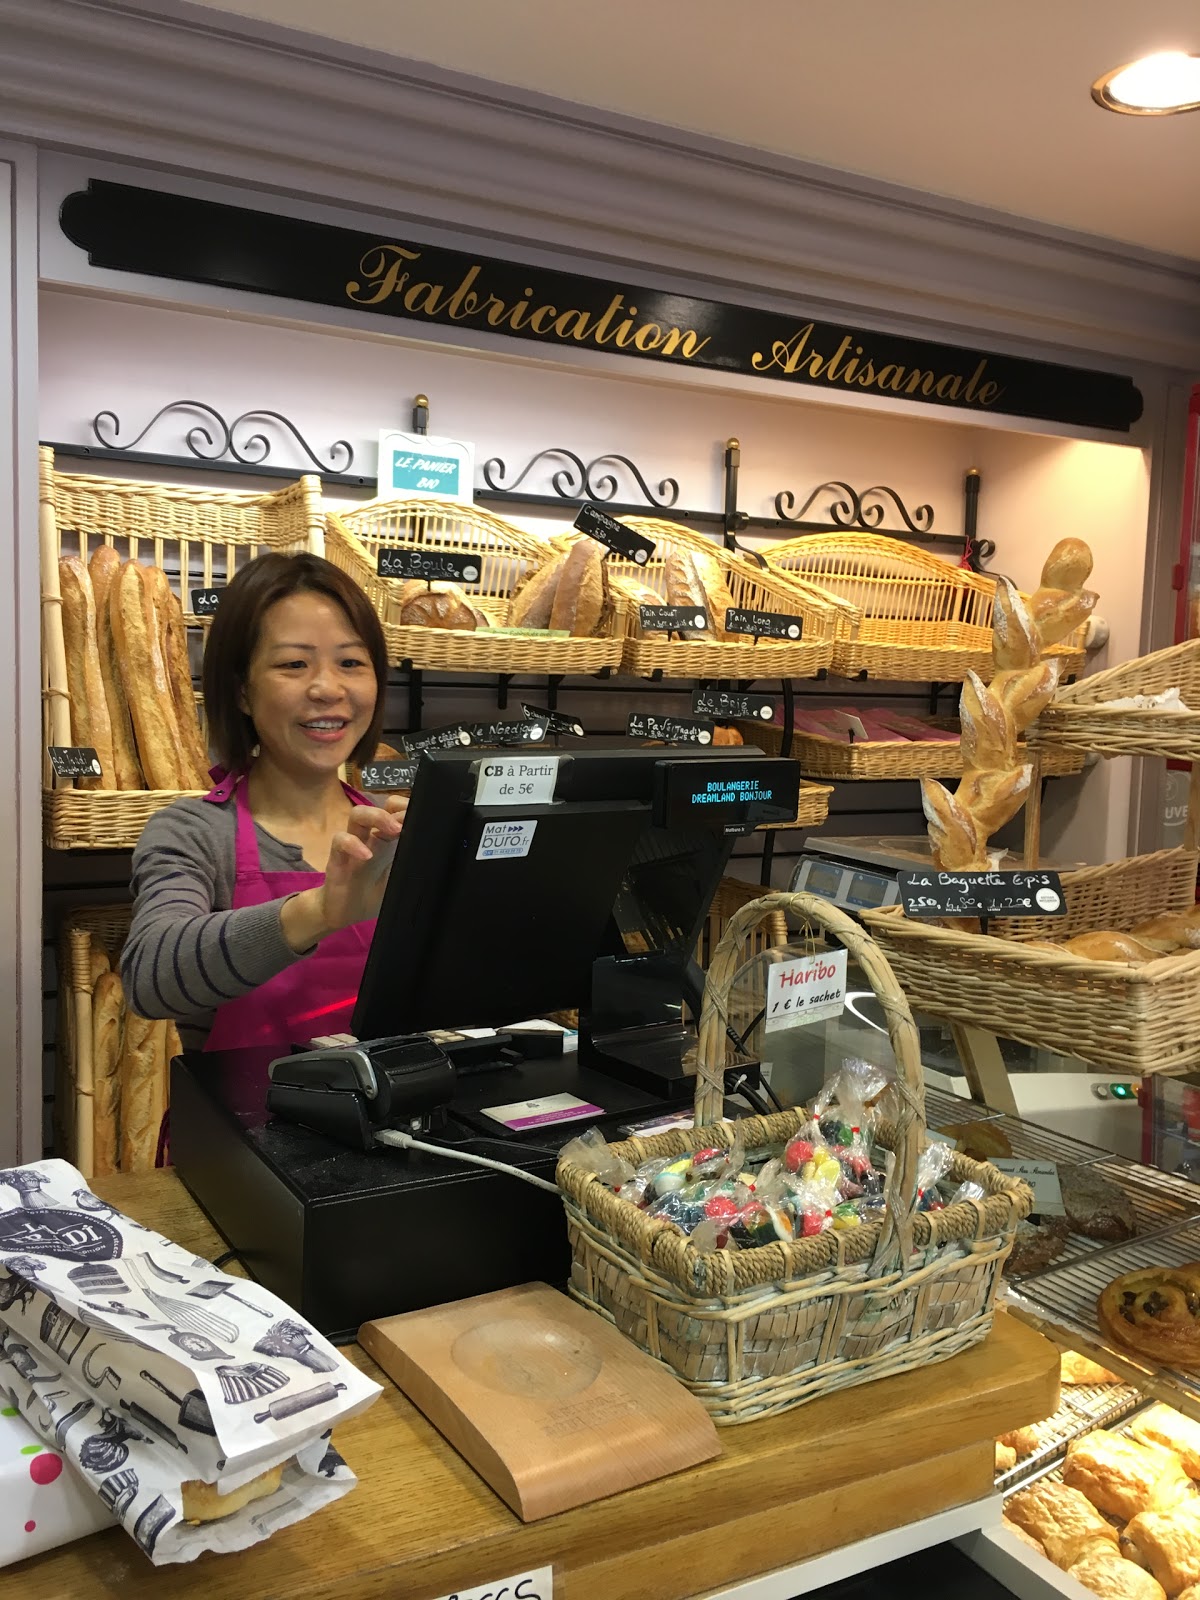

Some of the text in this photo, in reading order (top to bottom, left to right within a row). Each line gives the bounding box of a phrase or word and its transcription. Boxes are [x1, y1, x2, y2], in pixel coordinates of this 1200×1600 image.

[345, 245, 1006, 404] Fabrication Artisanale
[395, 457, 457, 474] LE PANIER
[416, 477, 440, 489] BIO
[381, 551, 404, 569] La
[409, 553, 456, 572] Boule
[640, 606, 656, 617] Pain
[728, 609, 747, 623] Pain
[753, 615, 771, 629] Long
[698, 693, 714, 707] Le
[630, 715, 644, 728] Le
[384, 764, 419, 778] Comp
[484, 765, 554, 777] CB à Partir
[499, 783, 534, 795] de 5€
[707, 781, 760, 792] BOULANGERIE
[691, 790, 772, 804] DREAMLAND BONJOUR
[486, 825, 507, 834] Mat
[482, 835, 529, 848] buro.fr
[907, 872, 1050, 894] La Baguette Epis
[779, 960, 836, 988] Haribo
[772, 988, 841, 1013] 1 € le sachet
